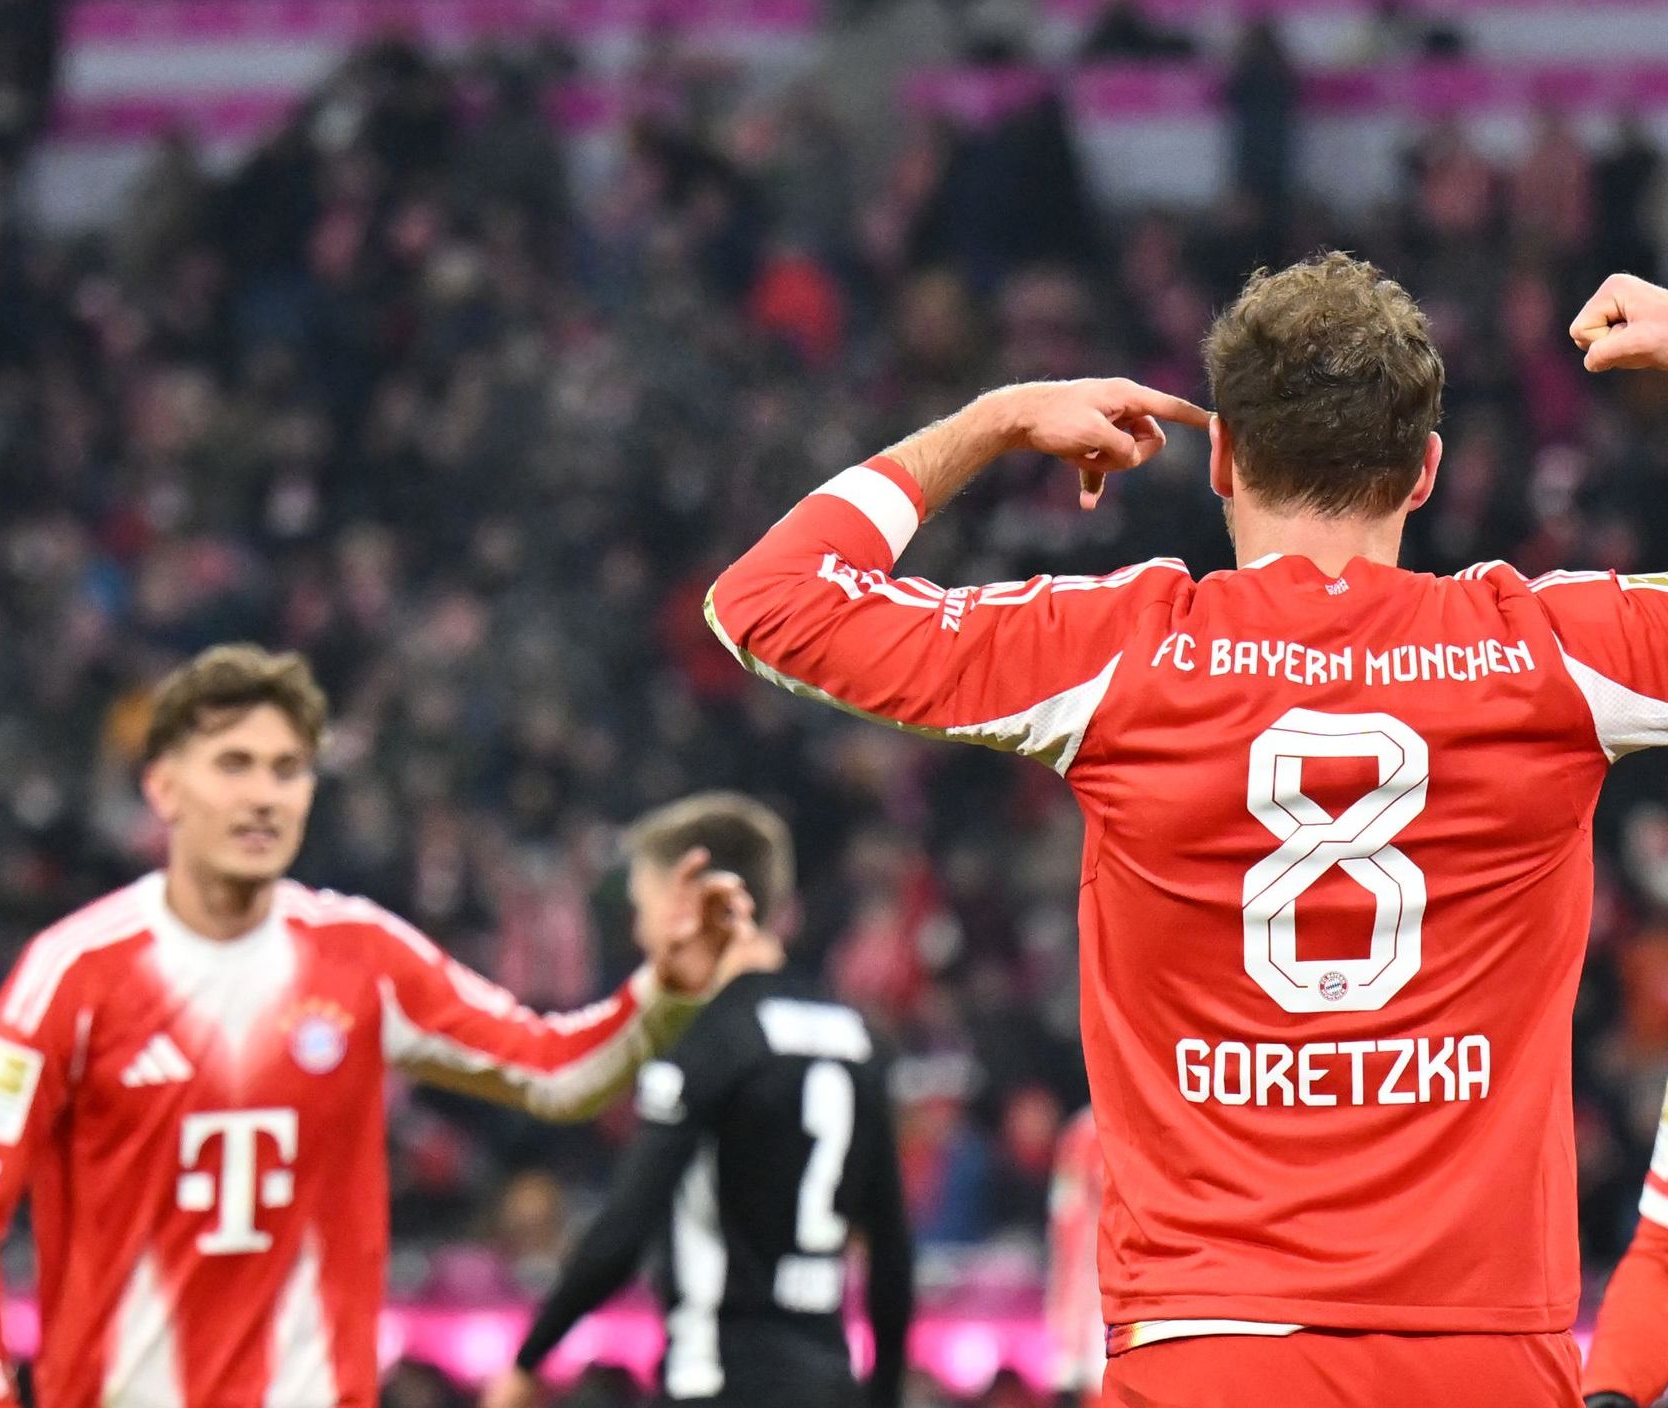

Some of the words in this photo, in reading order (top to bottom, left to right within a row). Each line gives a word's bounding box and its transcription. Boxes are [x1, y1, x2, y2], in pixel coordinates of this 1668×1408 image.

[1151, 632, 1196, 672] FC
[1210, 638, 1352, 686] BAYERN
[1364, 640, 1536, 687] MÜNCHEN
[1242, 707, 1430, 1013] 8
[1175, 1035, 1491, 1107] GORETZKA
[177, 1108, 298, 1256] T
